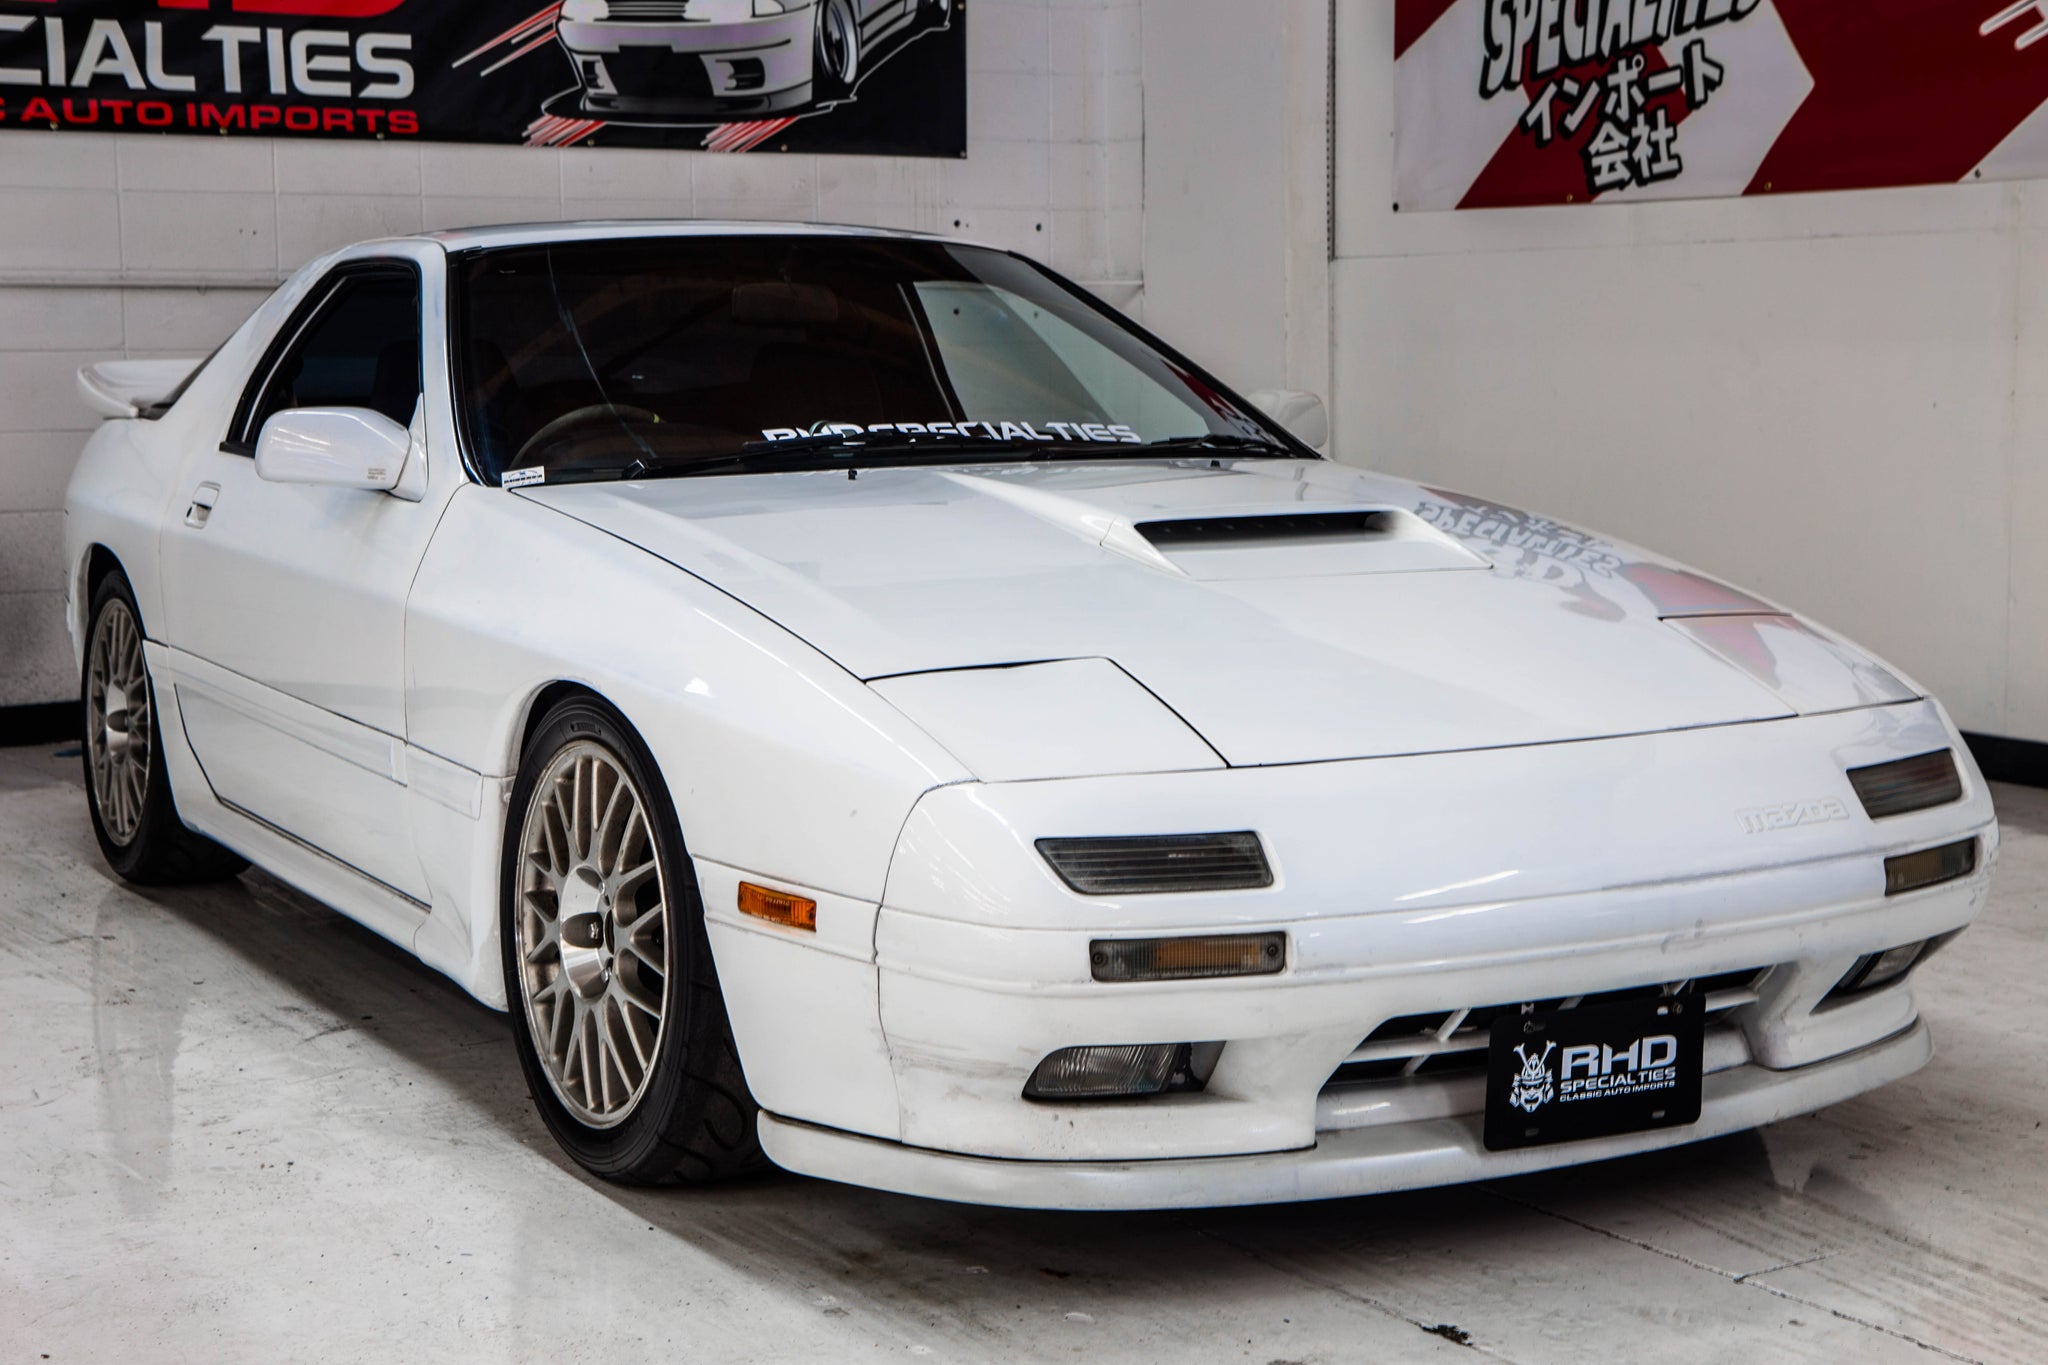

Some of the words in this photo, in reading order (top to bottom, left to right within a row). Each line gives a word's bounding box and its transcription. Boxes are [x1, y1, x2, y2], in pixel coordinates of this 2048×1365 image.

[1481, 0, 1757, 97] SPECIAL
[1521, 38, 1724, 143] インポート
[20, 96, 174, 126] AUTO
[186, 103, 420, 134] IMPORTS
[1584, 107, 1682, 189] 会社
[1734, 796, 1850, 834] mazda
[1560, 1034, 1678, 1081] RHD
[1559, 1090, 1602, 1103] CLASSIC
[1603, 1085, 1631, 1098] AUTO
[1632, 1079, 1676, 1094] IMPORTS
[1560, 1066, 1676, 1095] SPECIALTIES
